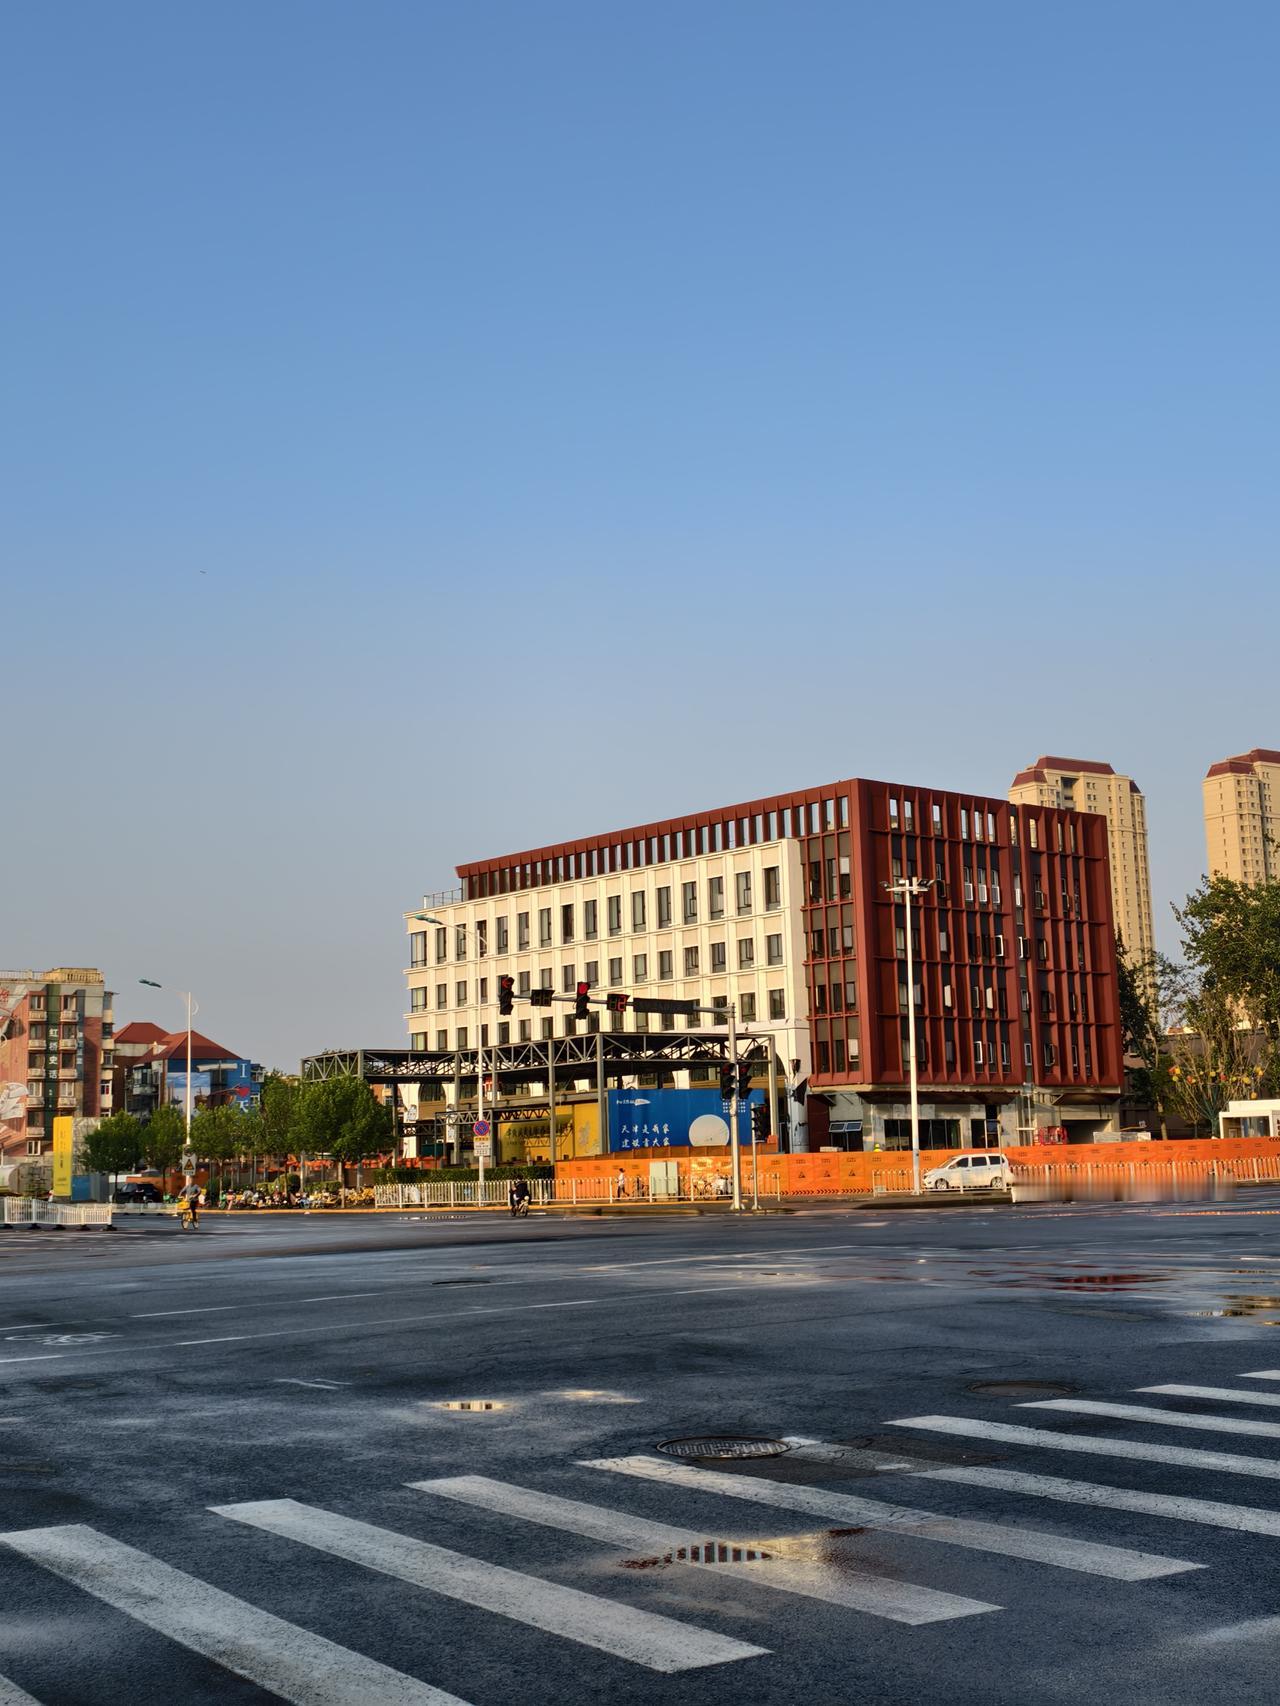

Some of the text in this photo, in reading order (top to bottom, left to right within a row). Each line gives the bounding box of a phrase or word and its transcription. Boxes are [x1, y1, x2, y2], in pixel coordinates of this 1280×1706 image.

[48, 1028, 58, 1079] 红桥史话
[621, 1123, 670, 1134] 天津是我家
